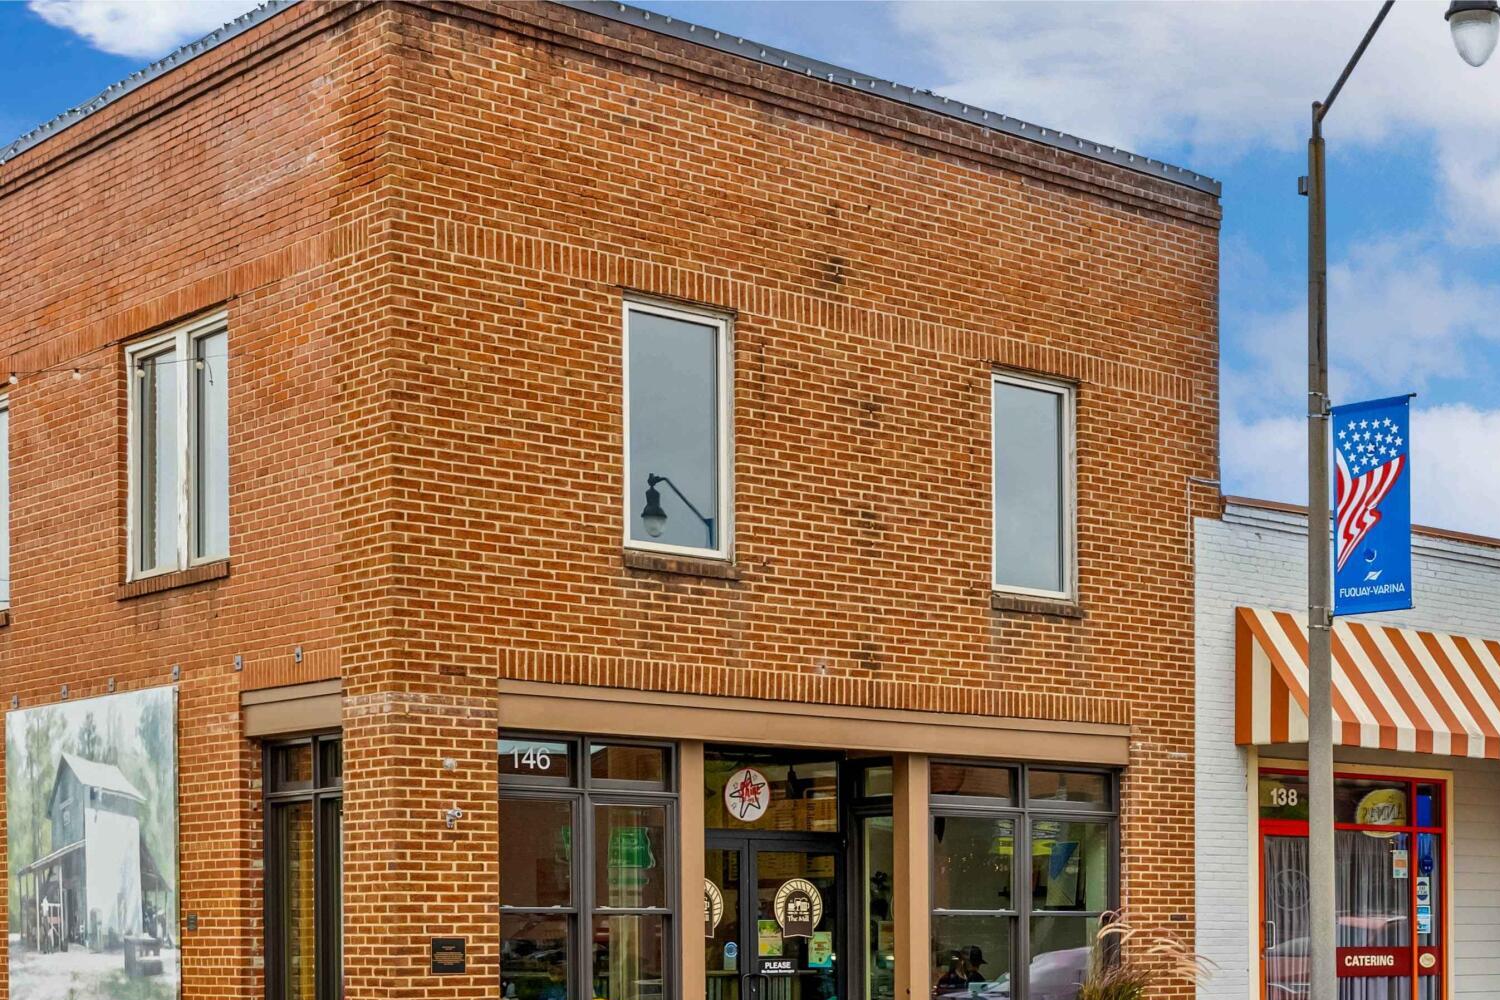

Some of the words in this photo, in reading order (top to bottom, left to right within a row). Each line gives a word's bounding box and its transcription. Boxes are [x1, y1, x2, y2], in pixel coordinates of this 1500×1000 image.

[1339, 582, 1405, 598] FUQUAY-VARINA
[510, 745, 550, 770] 146
[1270, 788, 1298, 806] 138
[764, 961, 791, 970] PLEASE
[1344, 955, 1394, 967] CATERING
